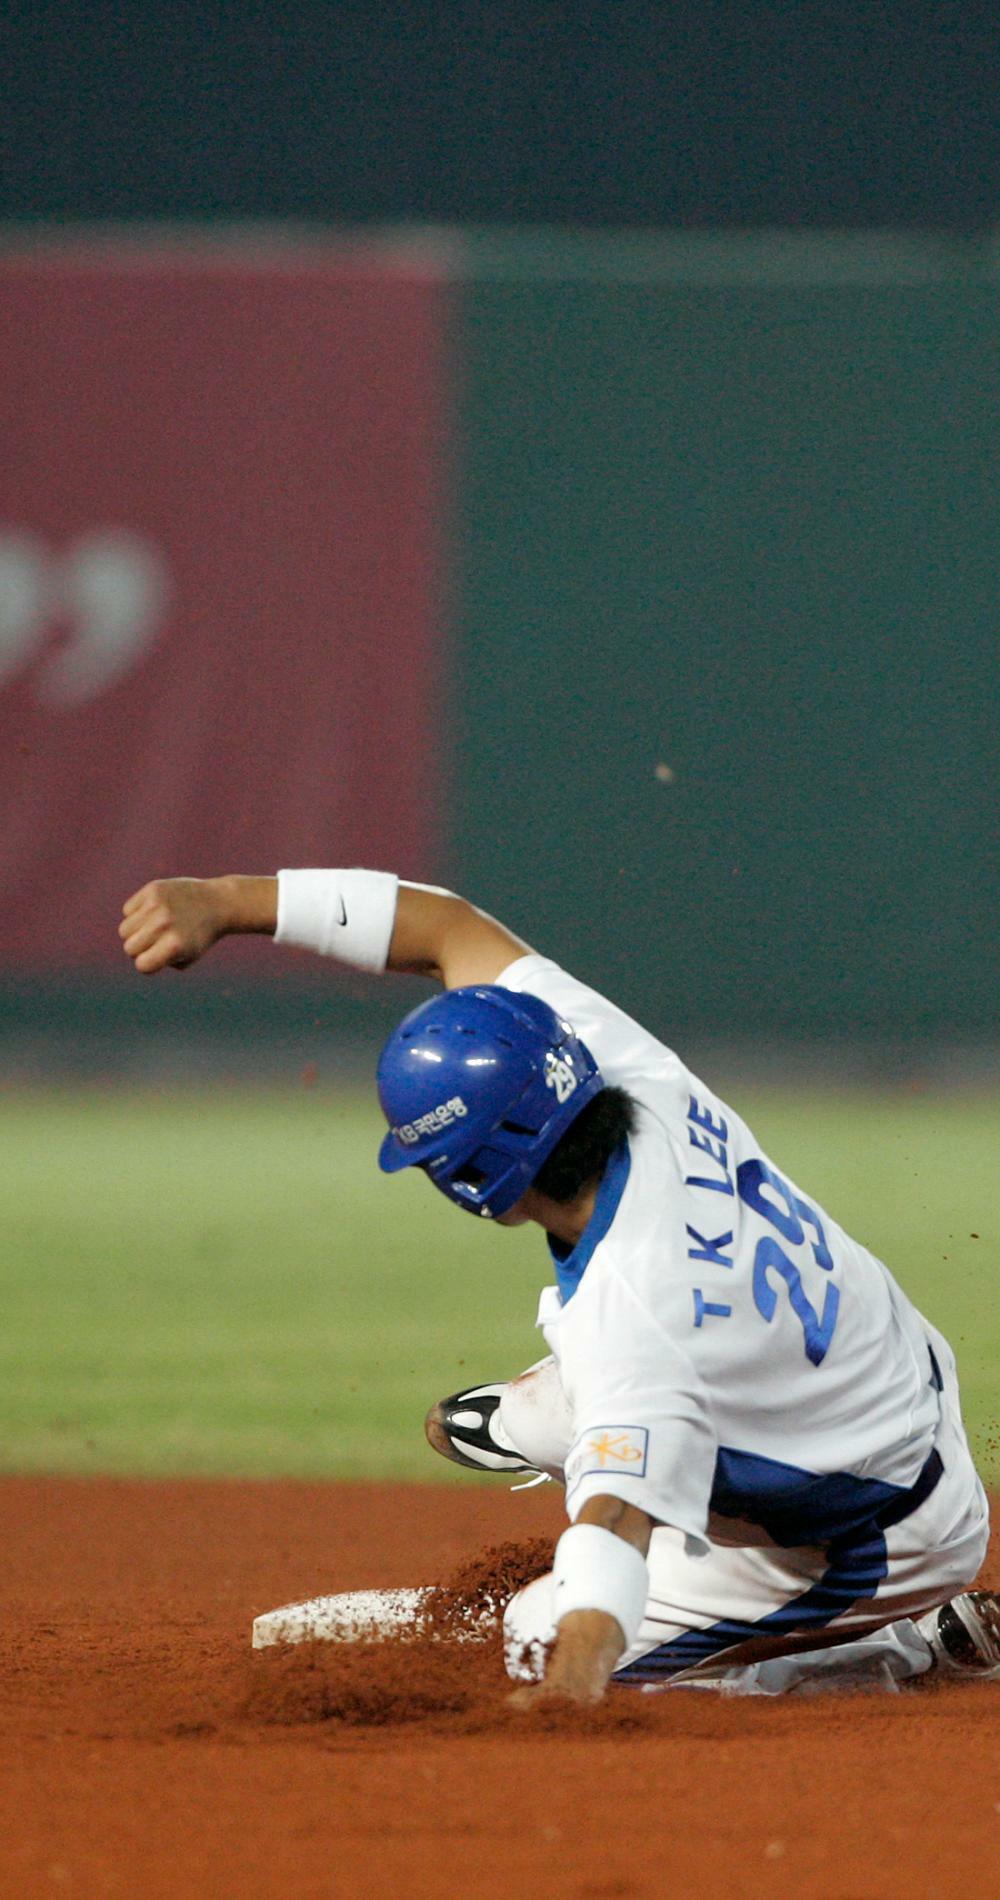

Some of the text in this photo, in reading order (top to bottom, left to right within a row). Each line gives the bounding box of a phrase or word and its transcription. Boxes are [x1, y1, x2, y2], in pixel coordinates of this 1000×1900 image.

[546, 1059, 577, 1104] 29
[685, 1095, 735, 1198] LEE
[736, 1158, 840, 1368] 29
